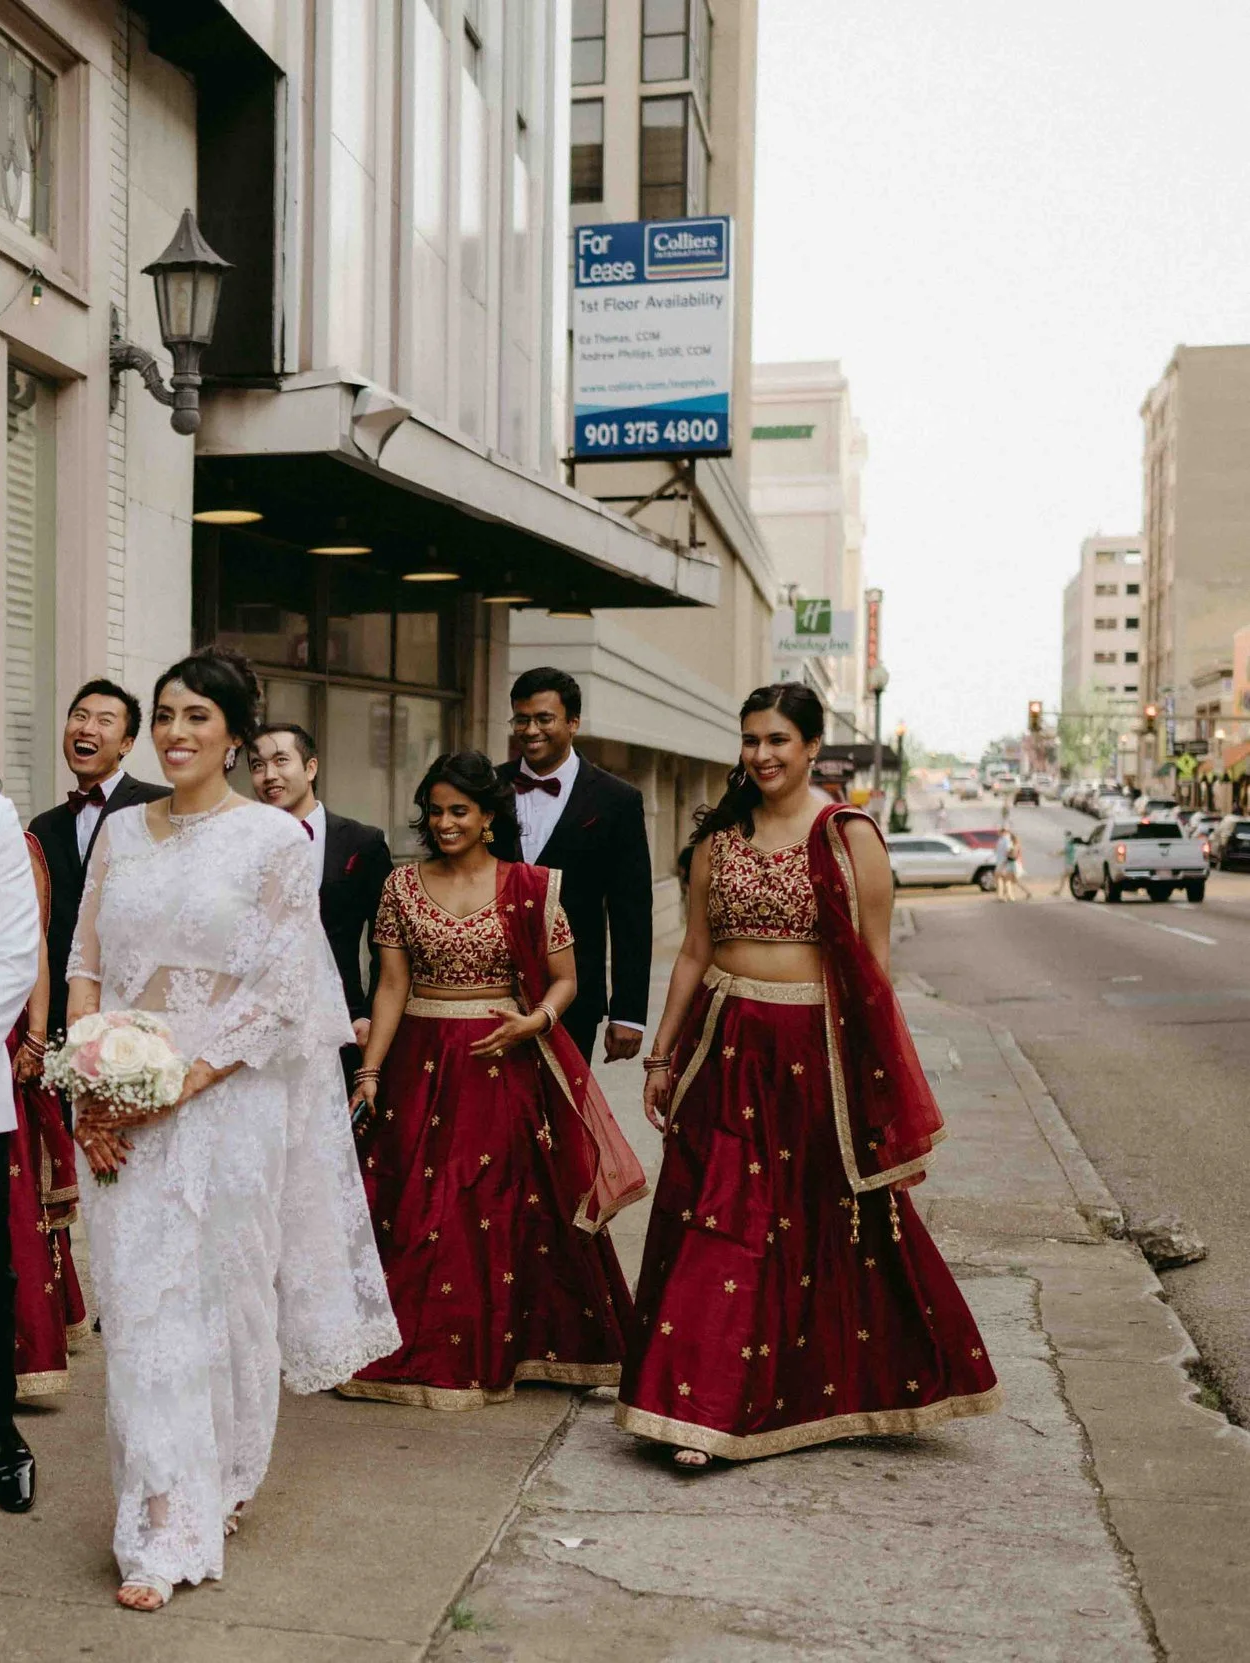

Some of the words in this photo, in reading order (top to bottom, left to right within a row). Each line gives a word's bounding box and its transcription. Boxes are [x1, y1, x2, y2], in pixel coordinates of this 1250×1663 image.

[578, 229, 613, 256] For
[653, 232, 718, 251] Colliers
[654, 249, 717, 258] INTERNATIONAL
[578, 258, 636, 284] Lease
[581, 300, 599, 313] 1st
[604, 297, 640, 312] Floor
[645, 292, 724, 310] Availability
[580, 351, 615, 361] Andrew
[584, 422, 619, 447] 901
[624, 420, 659, 444] 375
[663, 417, 719, 443] 4800
